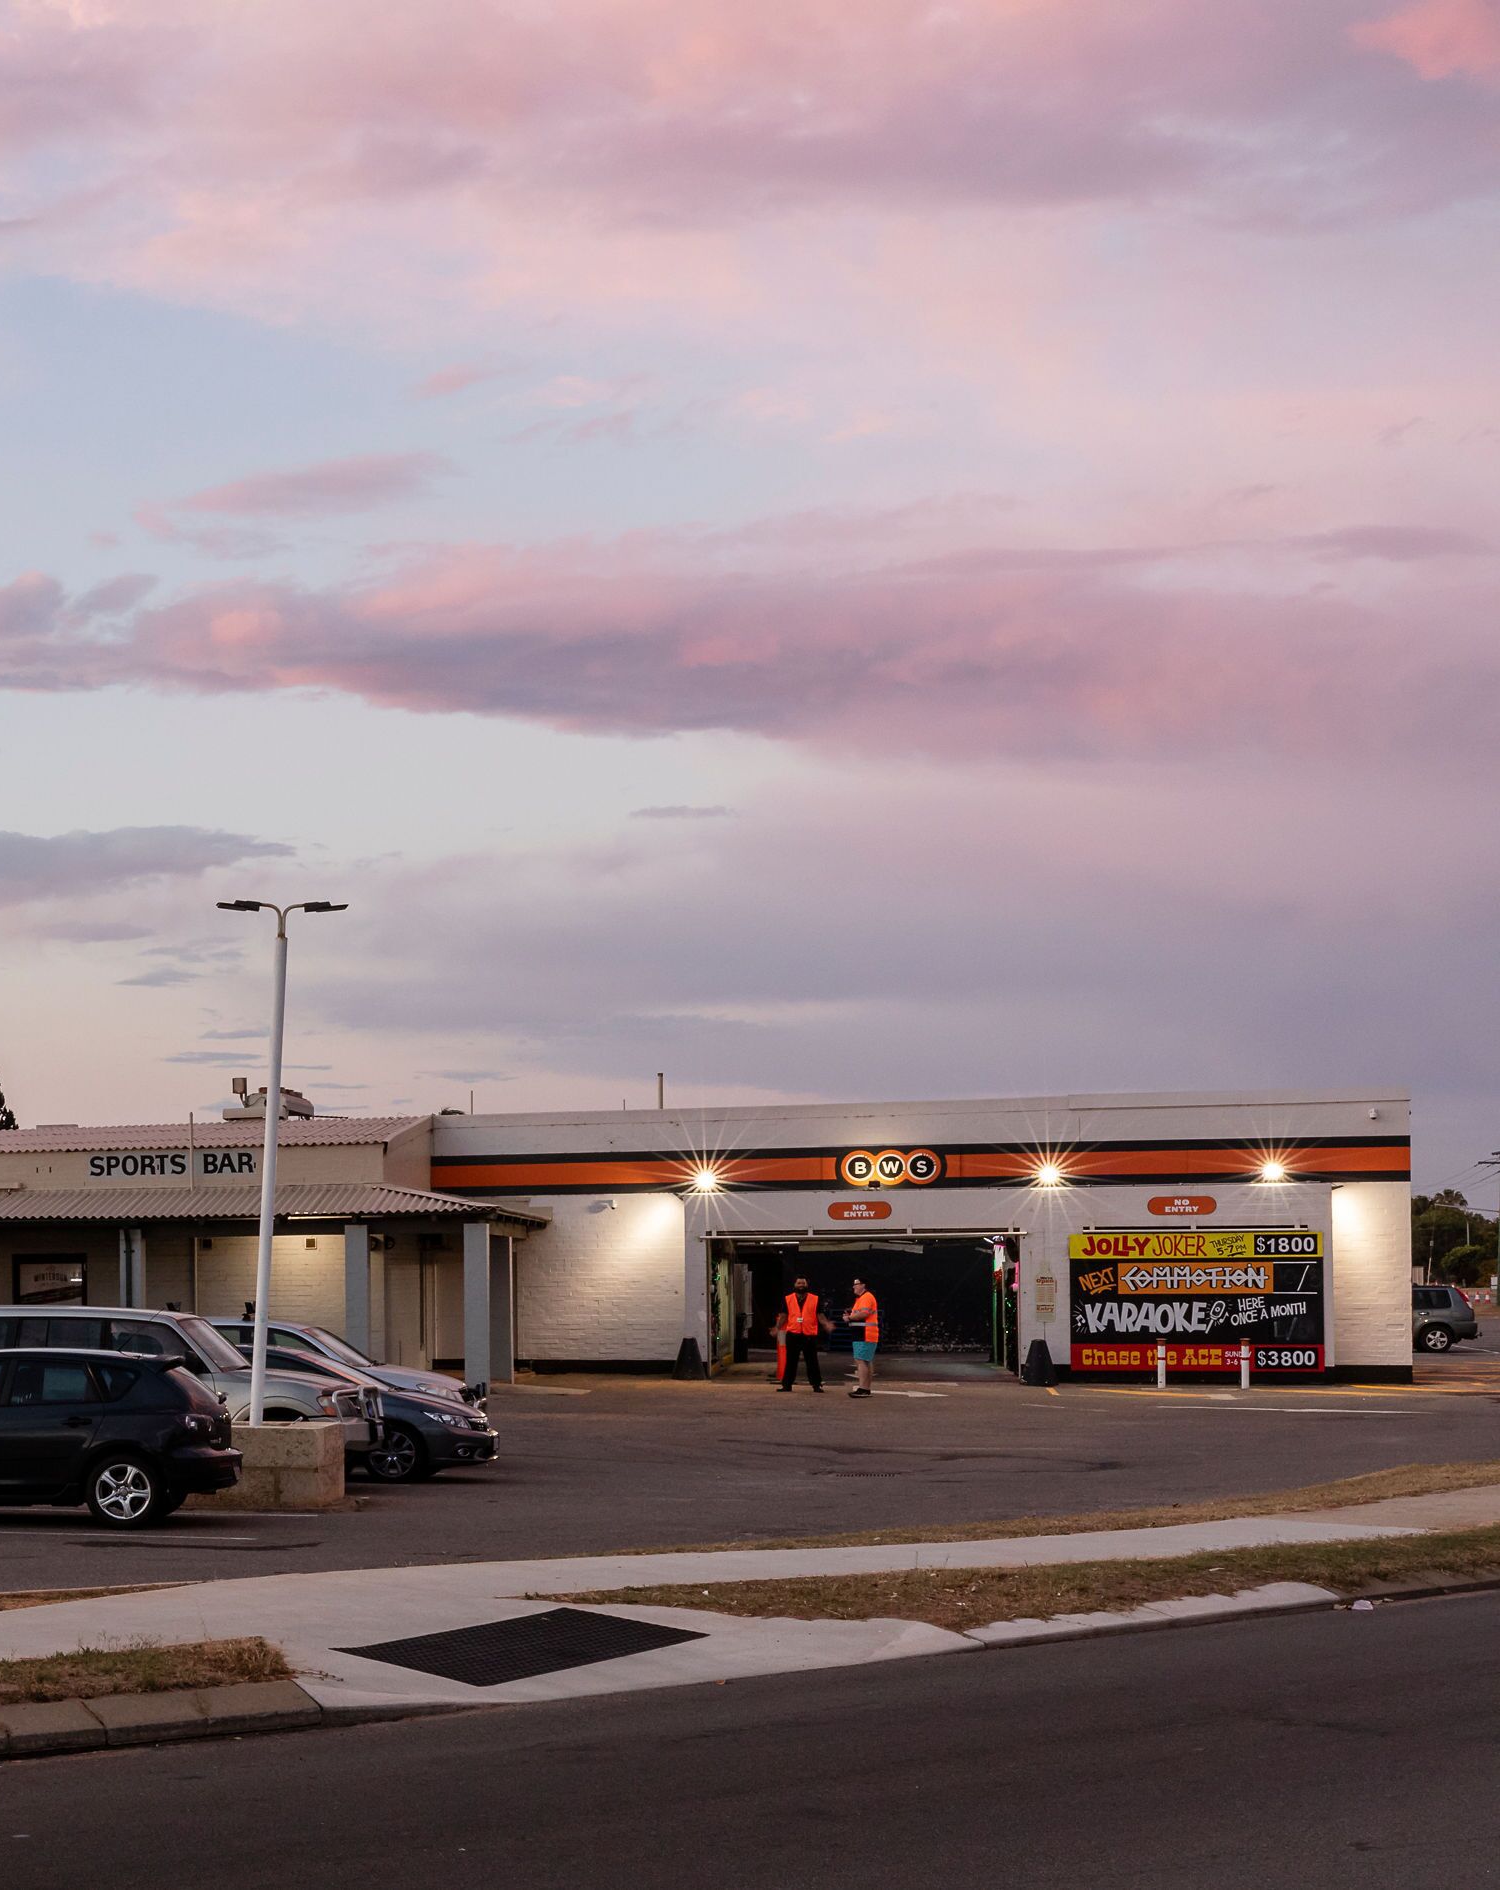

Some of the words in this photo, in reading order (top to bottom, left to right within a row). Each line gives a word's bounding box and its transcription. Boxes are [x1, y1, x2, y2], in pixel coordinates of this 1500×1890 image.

[89, 1153, 186, 1177] SPORTS
[203, 1152, 254, 1174] BAR
[843, 1210, 876, 1218] ENTRY
[1081, 1235, 1151, 1257] JOLLY
[1152, 1234, 1207, 1257] JOKER
[1209, 1234, 1245, 1249] THURSDAY
[1256, 1236, 1315, 1253] $1800
[1078, 1267, 1115, 1291] NEXT
[1237, 1296, 1266, 1312] HERE
[1084, 1302, 1207, 1334] KARAOKE
[1230, 1310, 1258, 1326] ONCE
[1260, 1308, 1269, 1320] A
[1270, 1301, 1307, 1318] MONTH
[1082, 1348, 1140, 1366] Chase
[1182, 1349, 1222, 1366] ACE
[1257, 1350, 1315, 1367] $3800
